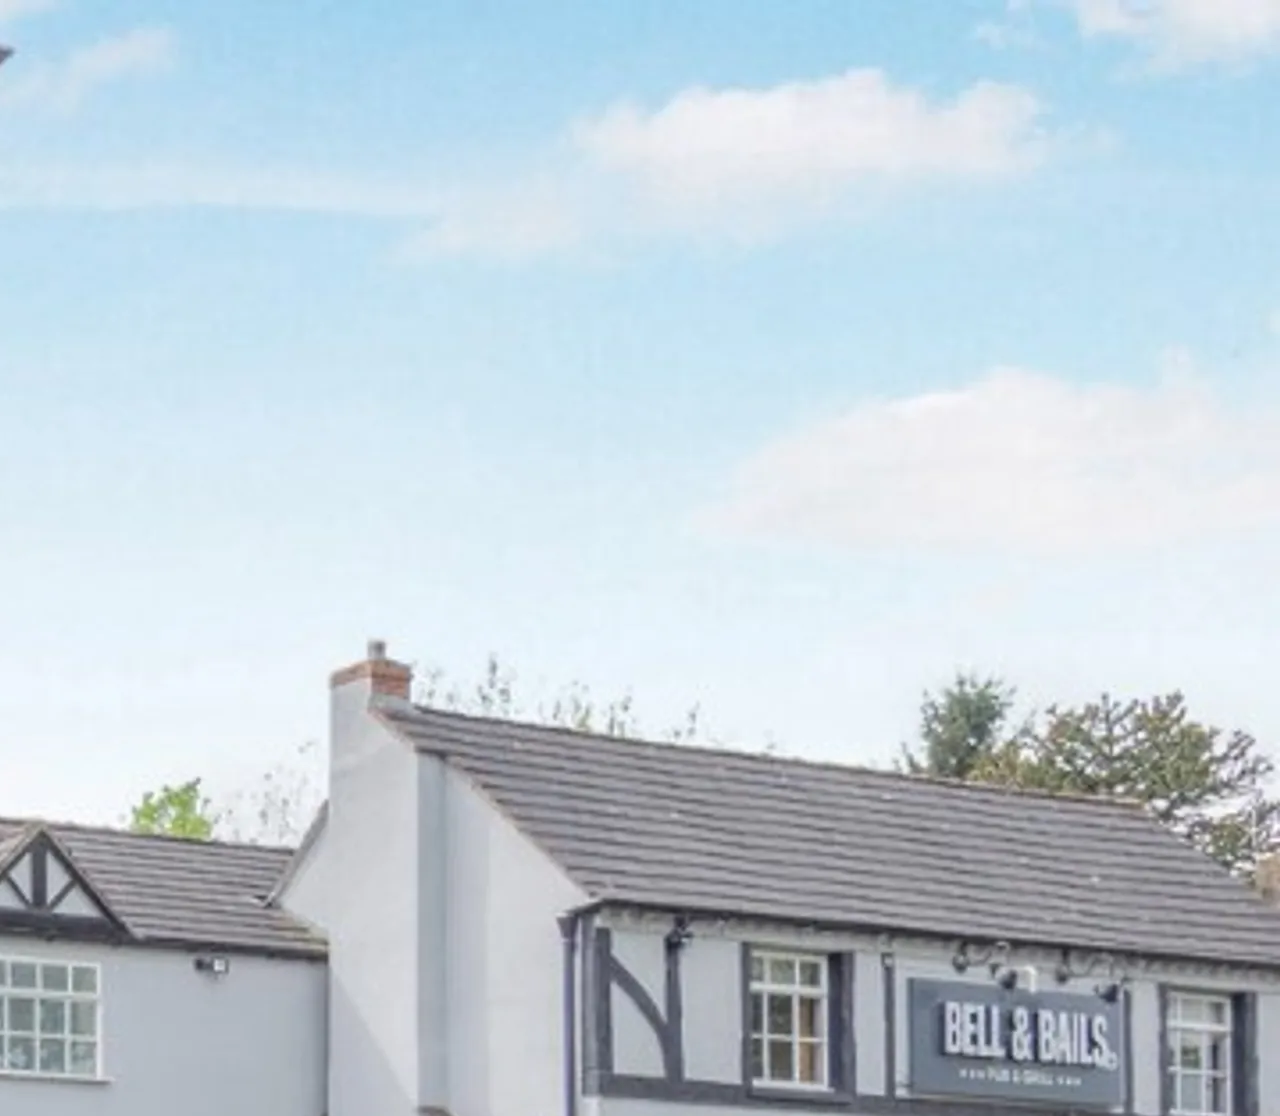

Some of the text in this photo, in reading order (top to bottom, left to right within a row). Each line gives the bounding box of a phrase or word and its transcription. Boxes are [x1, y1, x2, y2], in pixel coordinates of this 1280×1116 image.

[944, 1000, 1006, 1058] BELL
[1012, 1005, 1033, 1062] &
[987, 1066, 1010, 1082] PUB
[1023, 1069, 1054, 1086] GRILL
